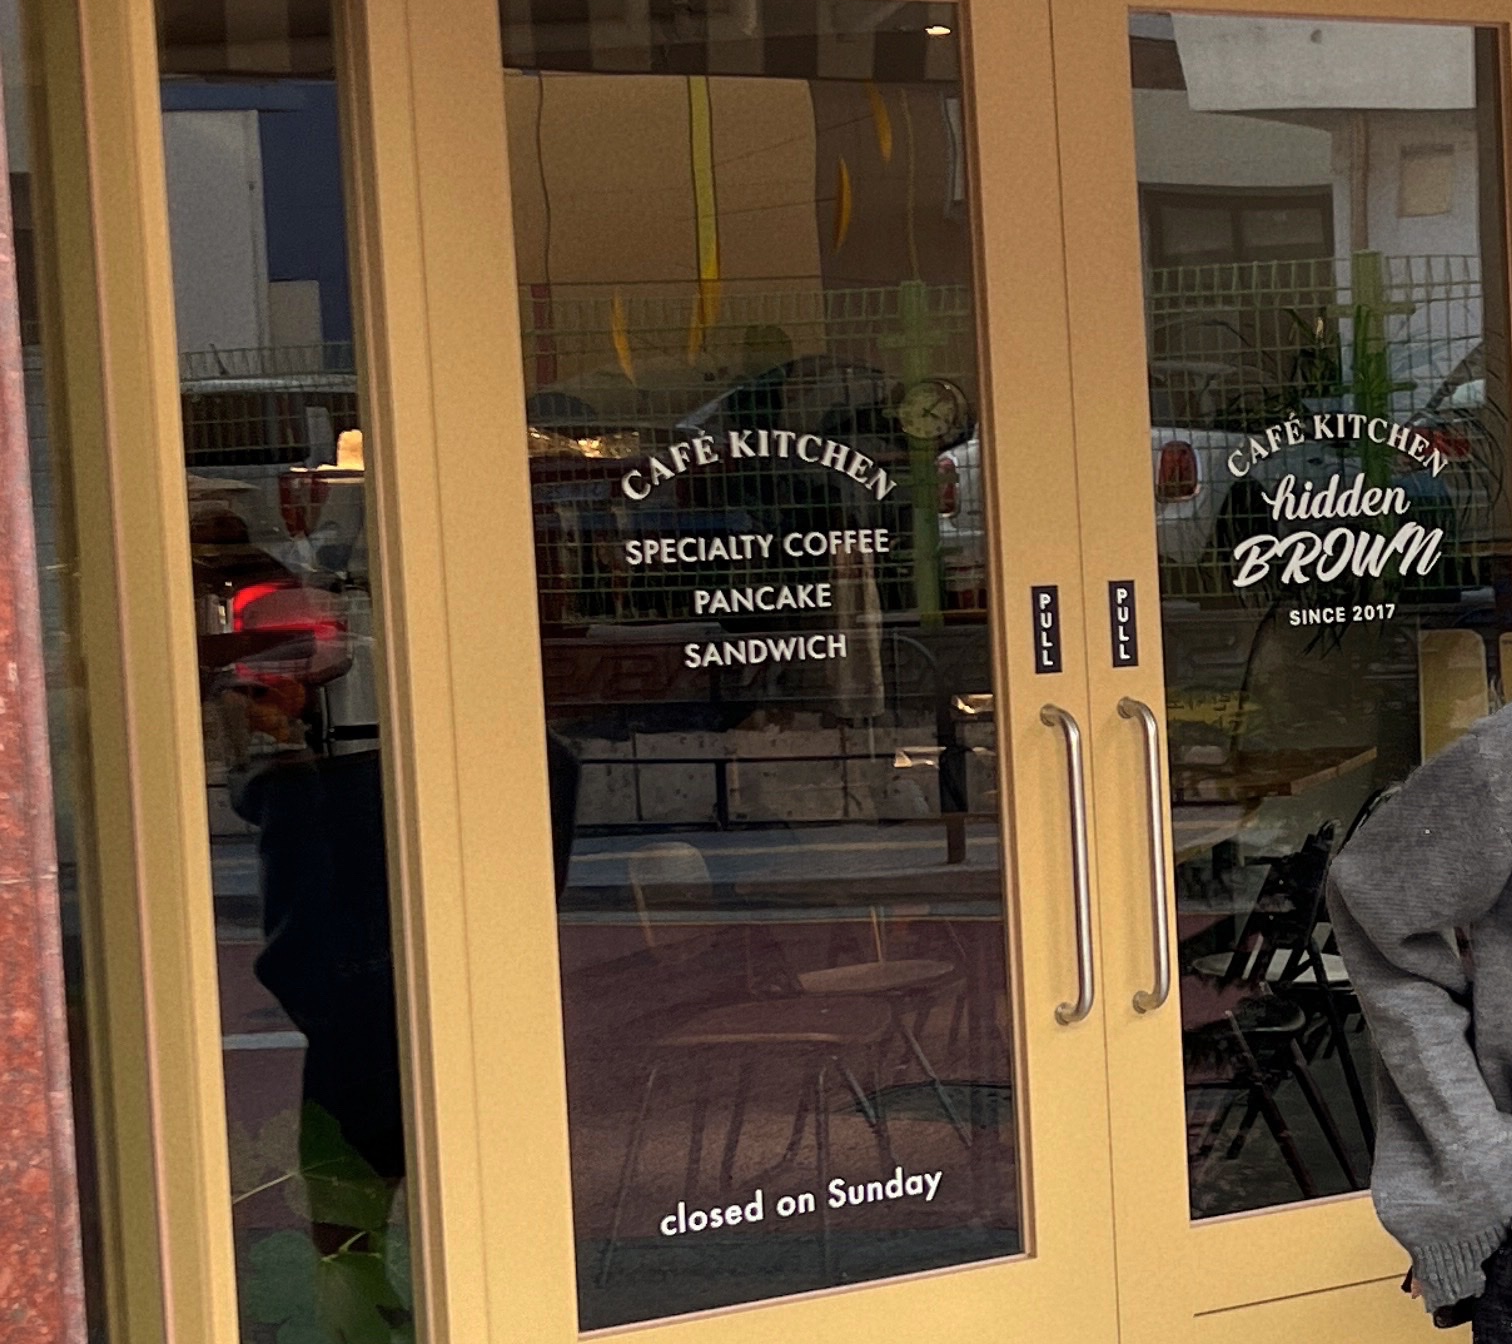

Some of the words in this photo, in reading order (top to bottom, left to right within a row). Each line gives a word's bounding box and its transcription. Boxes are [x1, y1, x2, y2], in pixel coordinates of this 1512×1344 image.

[621, 429, 720, 501] CAFÉ
[728, 429, 898, 501] KITCHEN
[1227, 412, 1305, 479] CAFÉ
[1313, 413, 1449, 479] KITCHEN
[1261, 472, 1412, 522] hidden
[625, 534, 774, 566] SPECIALTY
[783, 528, 890, 558] COFFEE
[1232, 521, 1444, 588] BROWN
[694, 583, 832, 614] PANCAKE
[1039, 593, 1054, 666] PULL
[1116, 587, 1131, 660] PULL
[1289, 606, 1347, 627] SINCE
[1353, 603, 1396, 623] 2017
[684, 634, 847, 669] SANDWICH
[660, 1189, 765, 1236] closed
[776, 1192, 816, 1217] on
[828, 1166, 943, 1209] Sunday
